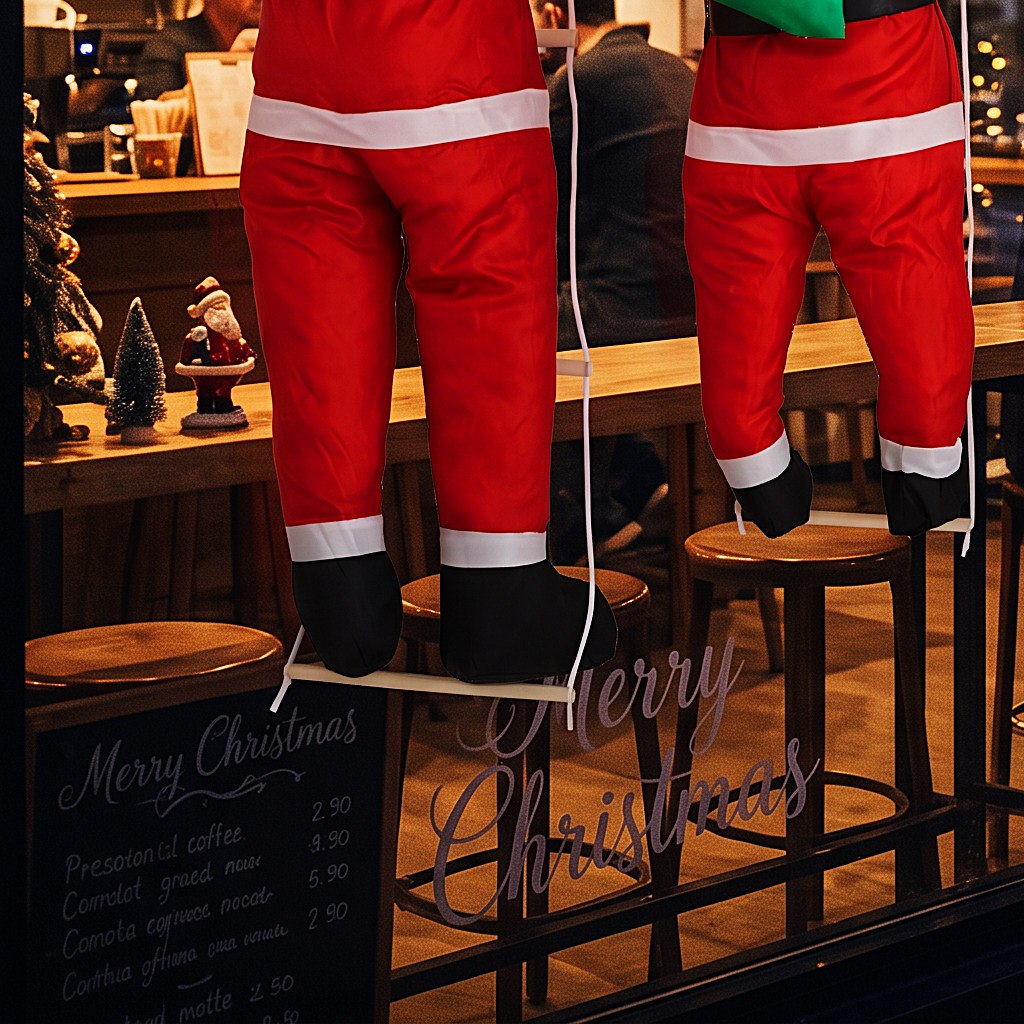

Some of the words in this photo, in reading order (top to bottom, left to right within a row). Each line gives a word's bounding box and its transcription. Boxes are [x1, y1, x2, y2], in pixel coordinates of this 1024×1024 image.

[58, 739, 184, 810] Merry
[196, 706, 357, 777] Christmas
[429, 737, 820, 926] Christmas
